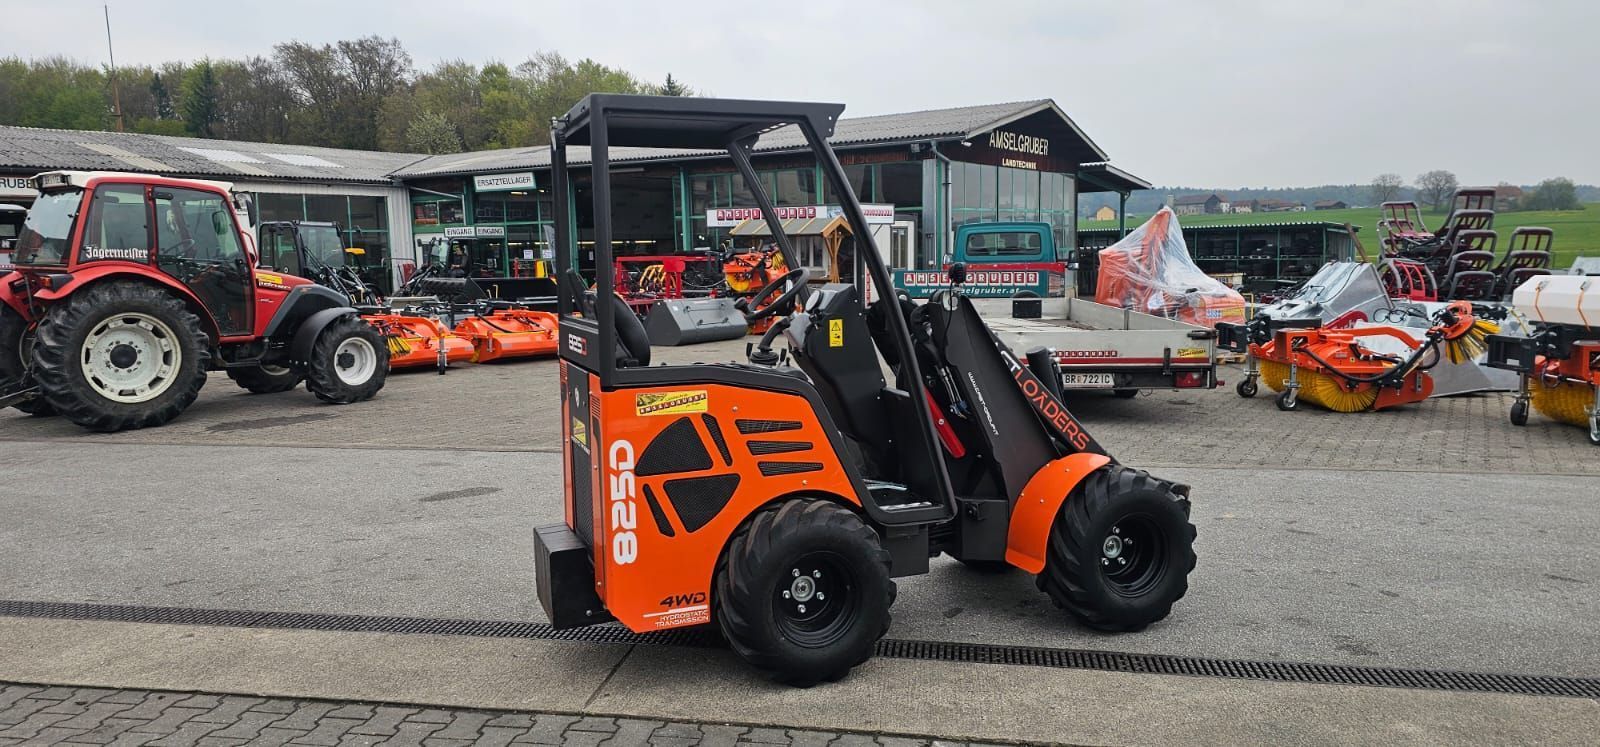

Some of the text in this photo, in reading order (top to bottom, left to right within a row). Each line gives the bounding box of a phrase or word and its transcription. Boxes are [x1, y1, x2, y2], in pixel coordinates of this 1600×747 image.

[989, 130, 1049, 155] AMSELGRUBER
[1002, 158, 1037, 169] LANDTECHNIK
[477, 176, 532, 187] ERSATZTEILLAGER
[447, 228, 473, 236] EINGANG
[477, 227, 503, 235] EINGANG
[904, 272, 1039, 285] AMSEGRUBER
[1065, 374, 1077, 384] BR
[1014, 369, 1090, 451] LOADERS
[659, 592, 706, 608] 4WD
